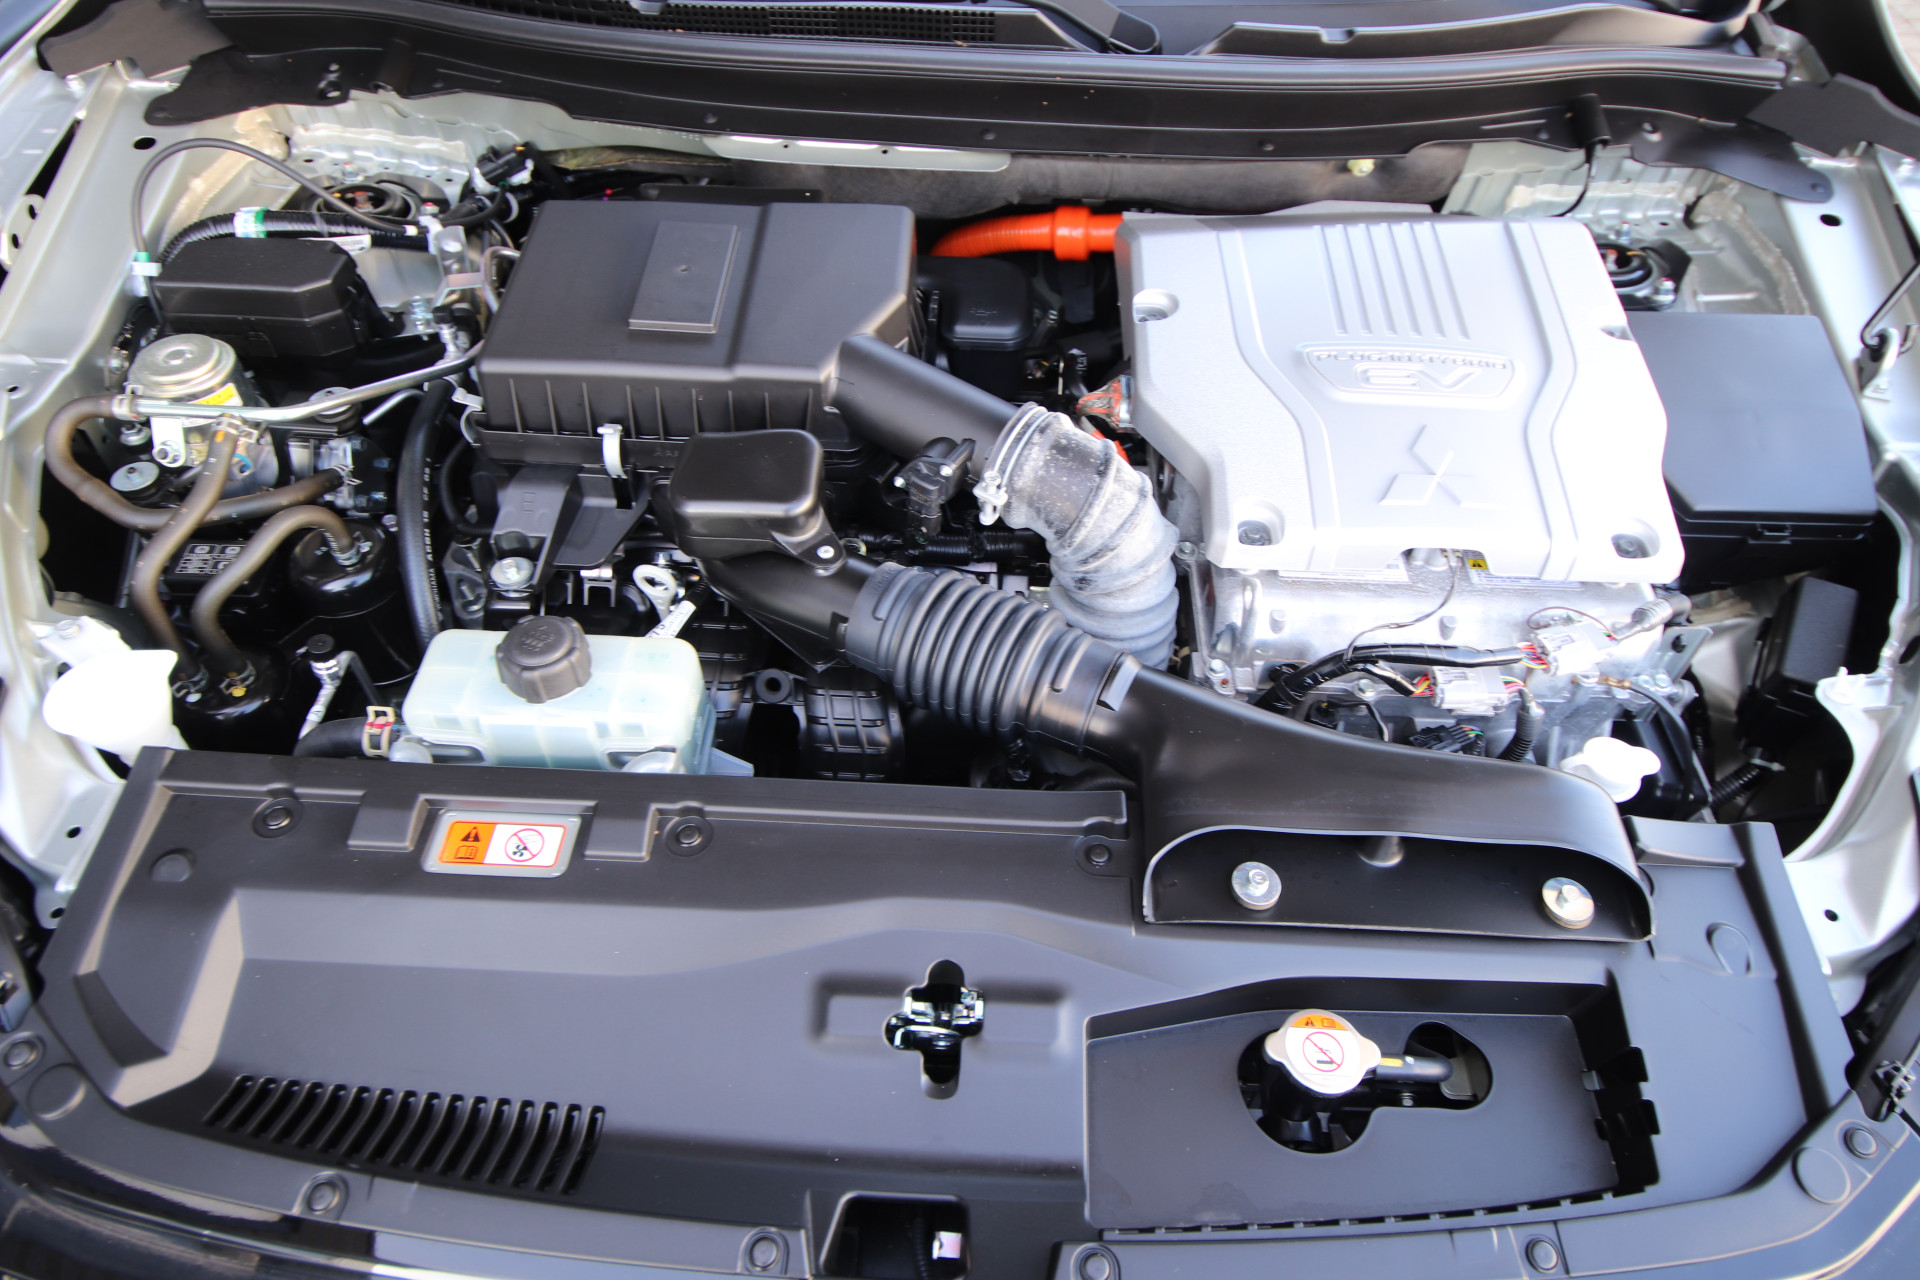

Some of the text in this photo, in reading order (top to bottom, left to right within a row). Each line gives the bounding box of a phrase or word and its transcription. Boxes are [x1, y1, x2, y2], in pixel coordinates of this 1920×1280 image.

[1312, 350, 1508, 370] PLUG-IN HYBRID
[1355, 362, 1484, 392] EV
